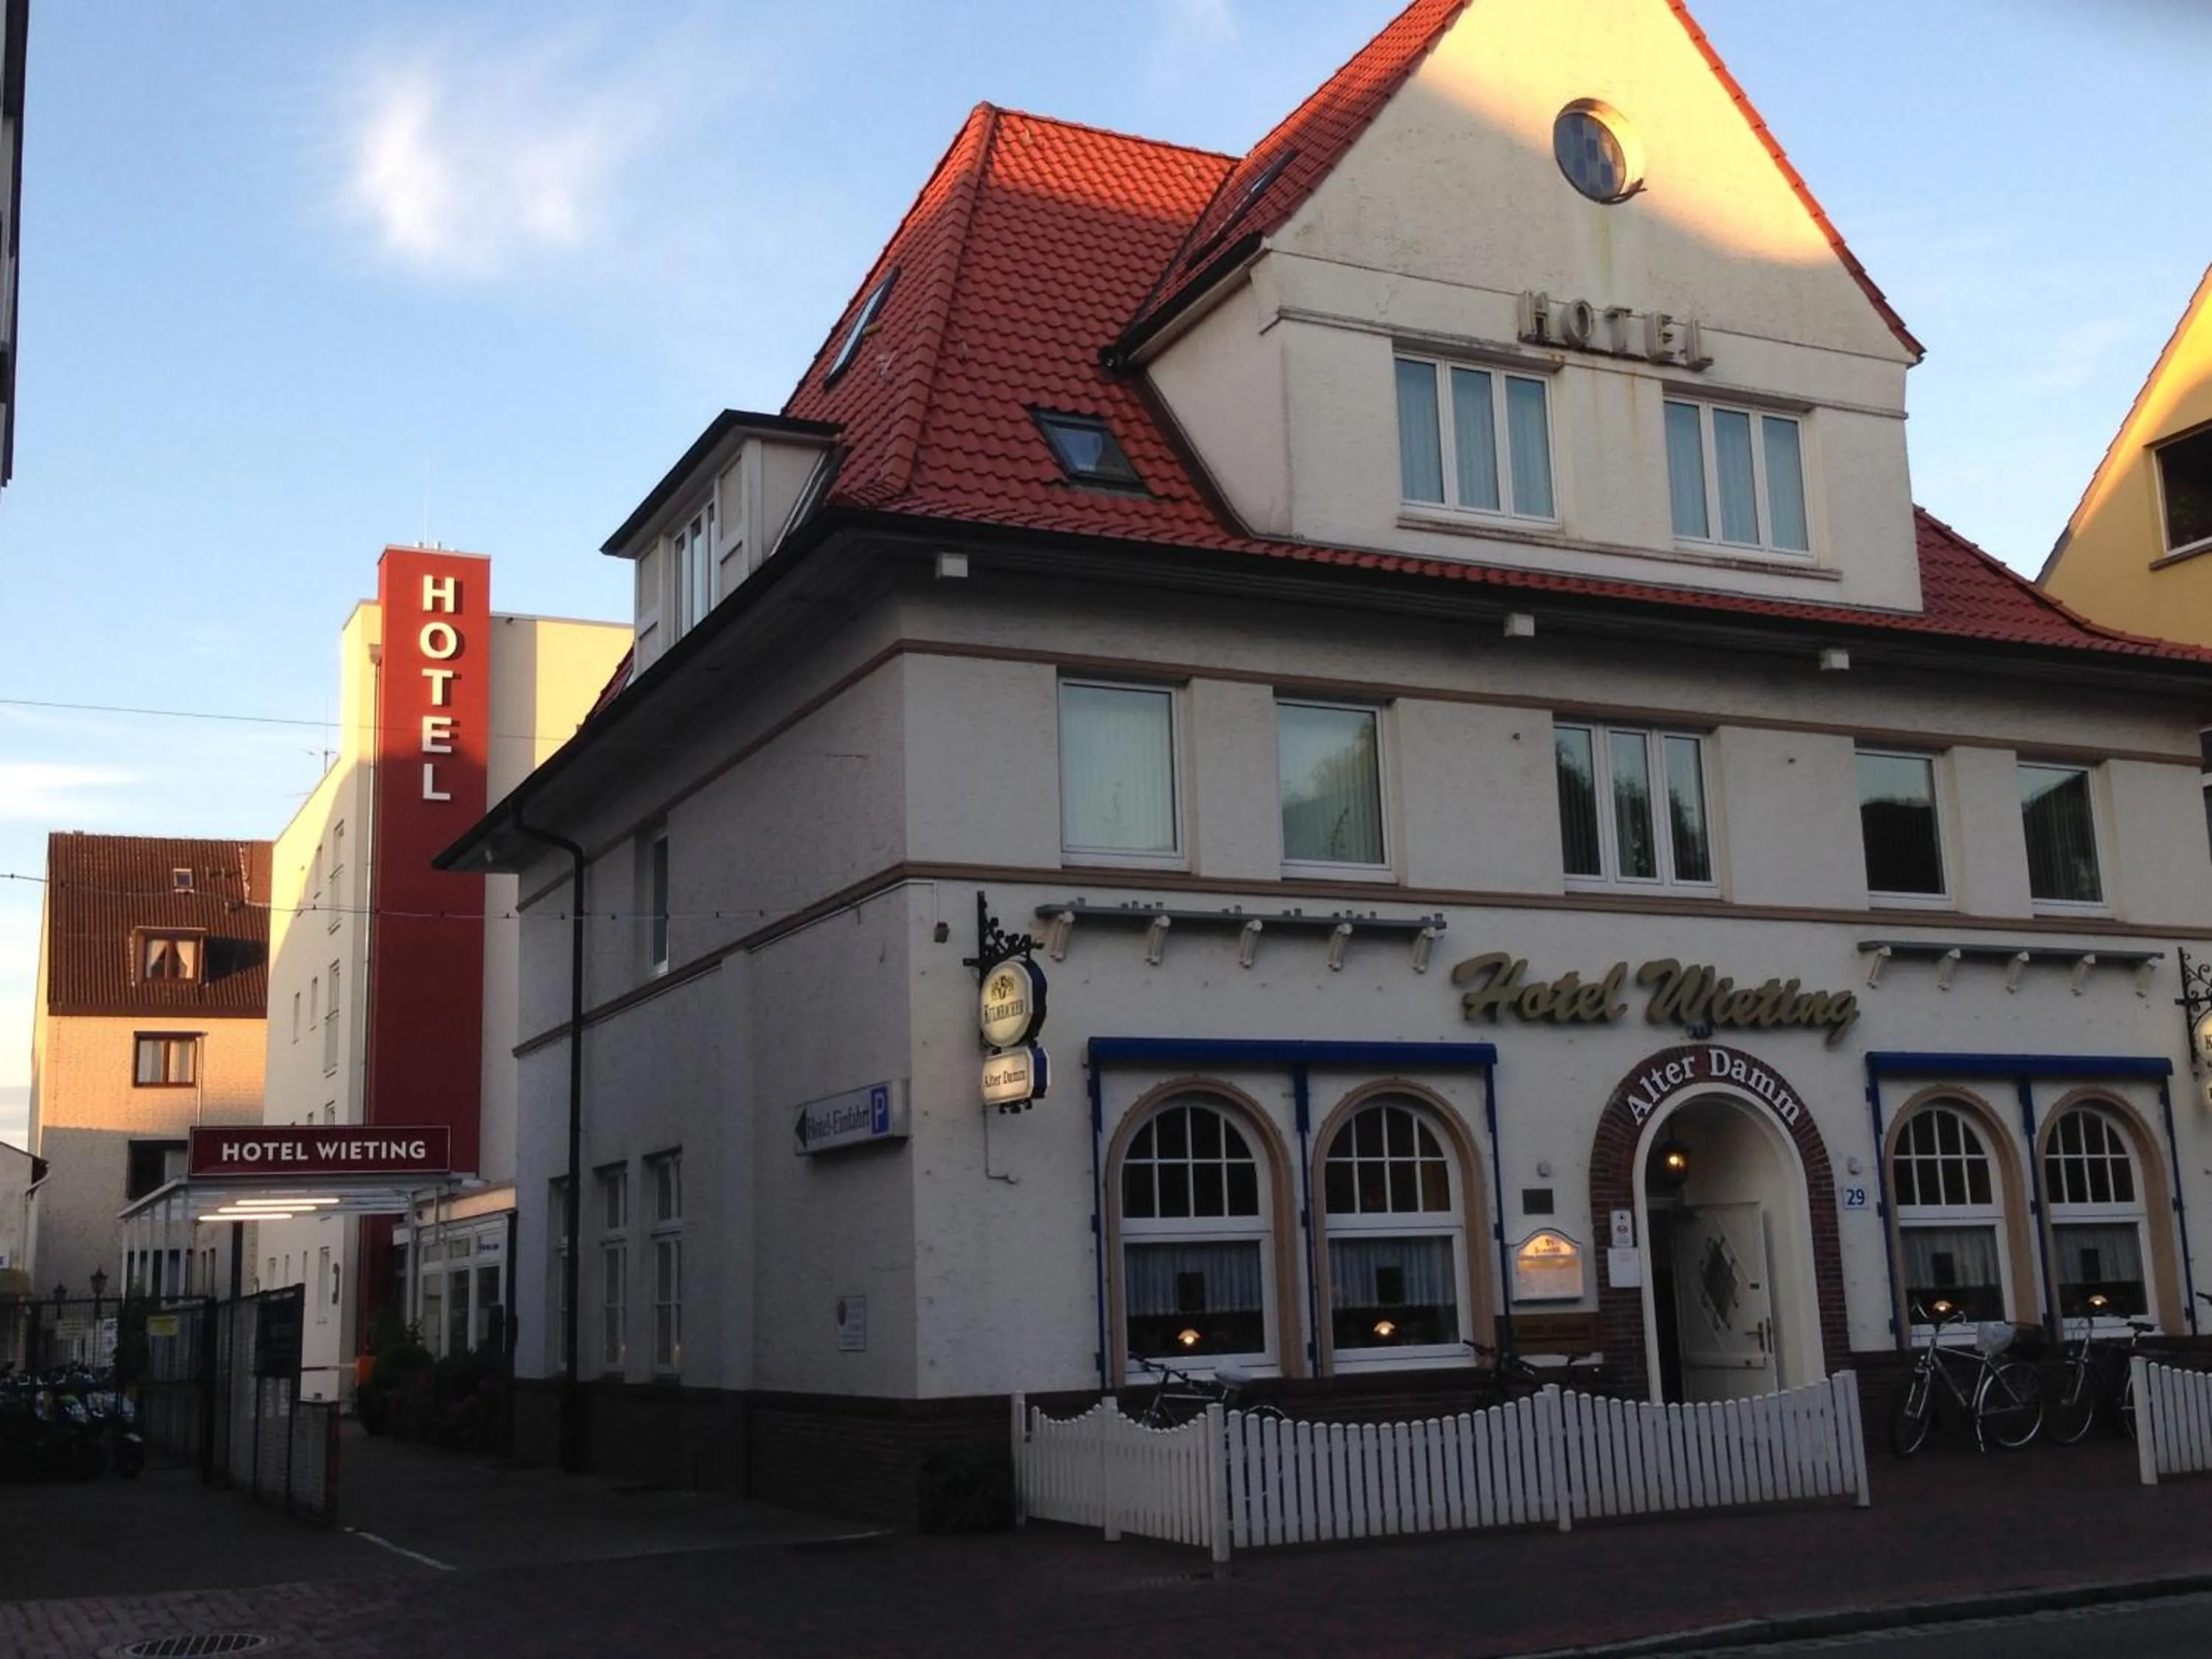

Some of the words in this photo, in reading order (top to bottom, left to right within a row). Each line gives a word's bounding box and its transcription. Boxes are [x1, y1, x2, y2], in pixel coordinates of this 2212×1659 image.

[1517, 290, 1714, 372] HOTEL
[419, 574, 458, 801] HOTEL
[1450, 951, 1628, 1023] Hotel
[1635, 958, 1860, 1046] Wieting
[984, 1074, 1001, 1088] Alter
[1004, 1070, 1026, 1085] Damm
[1625, 1054, 1695, 1125] Alter
[1709, 1049, 1803, 1126] Damm
[874, 1091, 886, 1131] P
[222, 1142, 308, 1161] HOTEL
[316, 1141, 425, 1160] WIETING
[1846, 1188, 1865, 1206] 29
